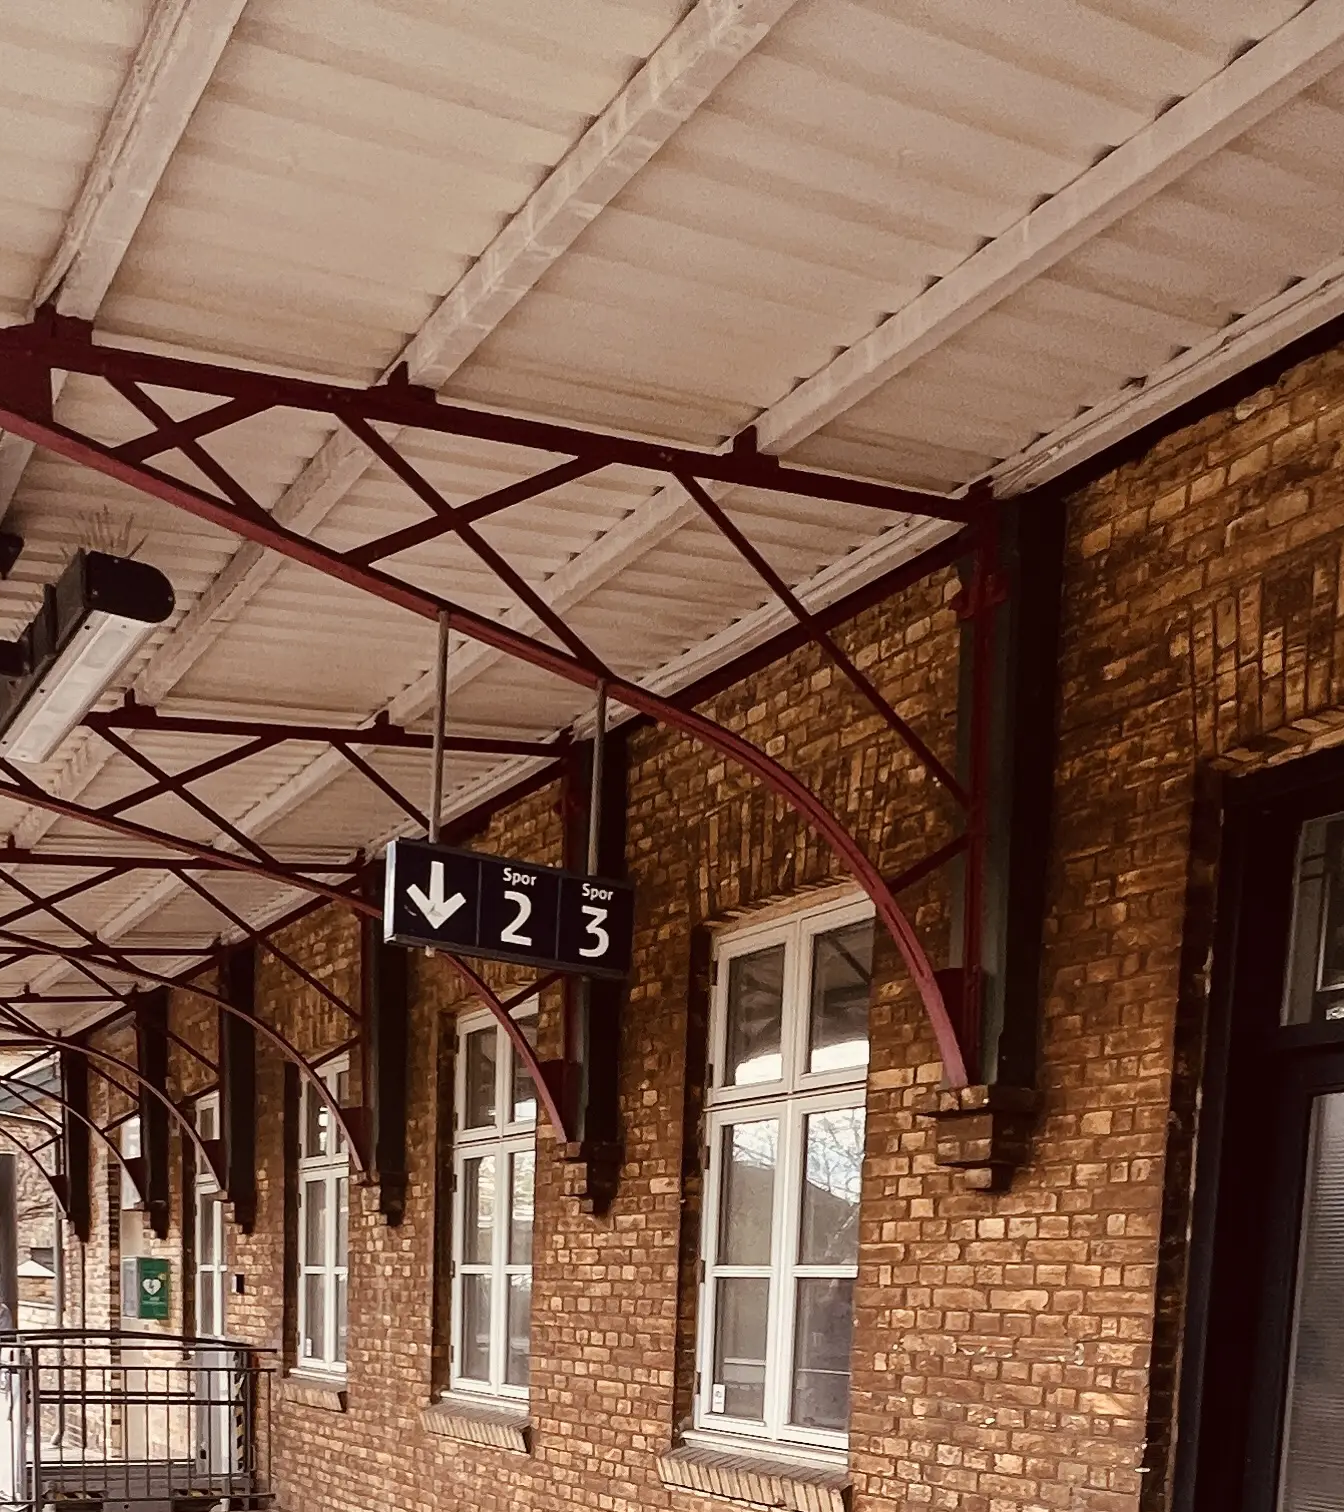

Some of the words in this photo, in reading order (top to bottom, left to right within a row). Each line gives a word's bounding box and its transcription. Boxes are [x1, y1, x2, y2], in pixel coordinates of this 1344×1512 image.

[502, 867, 537, 886] Spor
[581, 882, 614, 901] Spor
[500, 890, 533, 947] 2
[578, 904, 610, 958] 3
